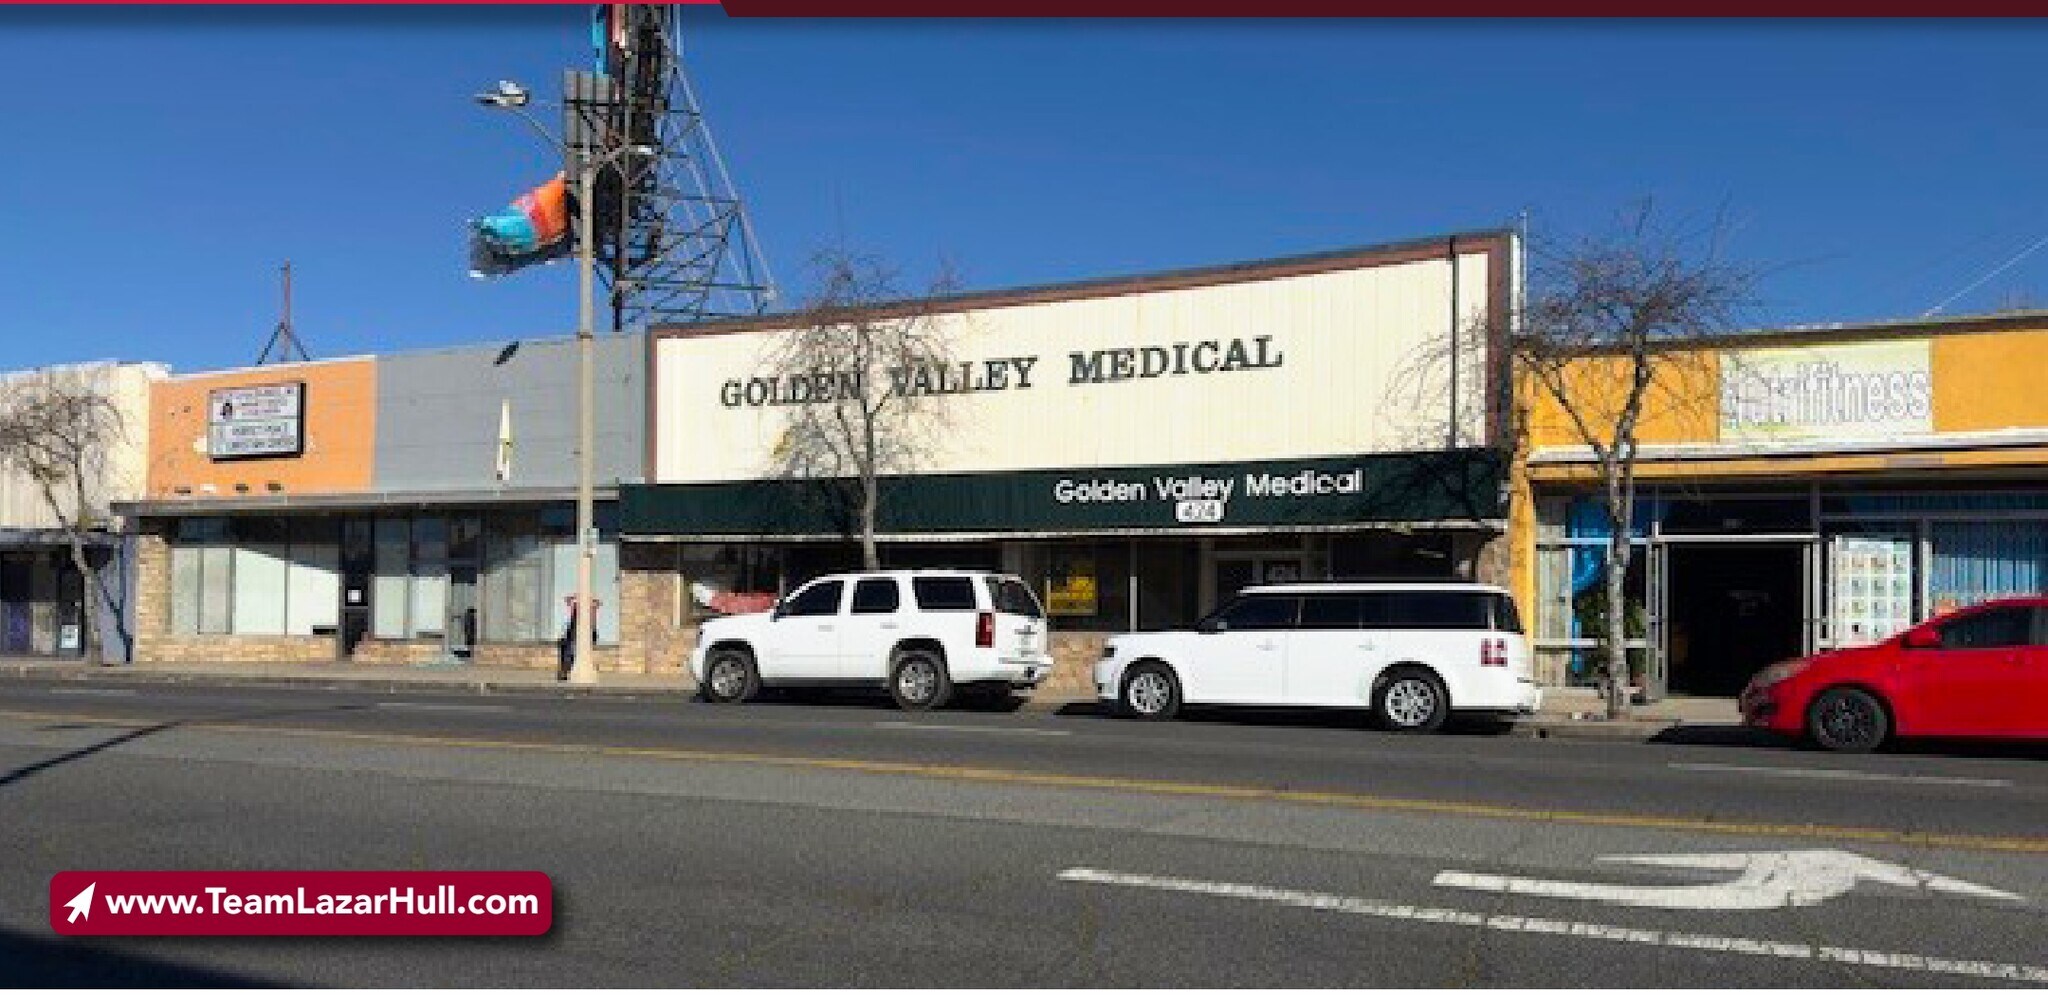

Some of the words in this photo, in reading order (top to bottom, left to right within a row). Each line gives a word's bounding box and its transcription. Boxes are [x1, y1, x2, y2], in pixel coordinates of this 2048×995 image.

[720, 371, 867, 409] GOLDEN
[886, 354, 1038, 396] VALLEY
[1067, 335, 1283, 385] MEDICAL
[1054, 478, 1147, 503] Golden
[1153, 476, 1234, 503] Valley
[1246, 467, 1364, 497] Medical
